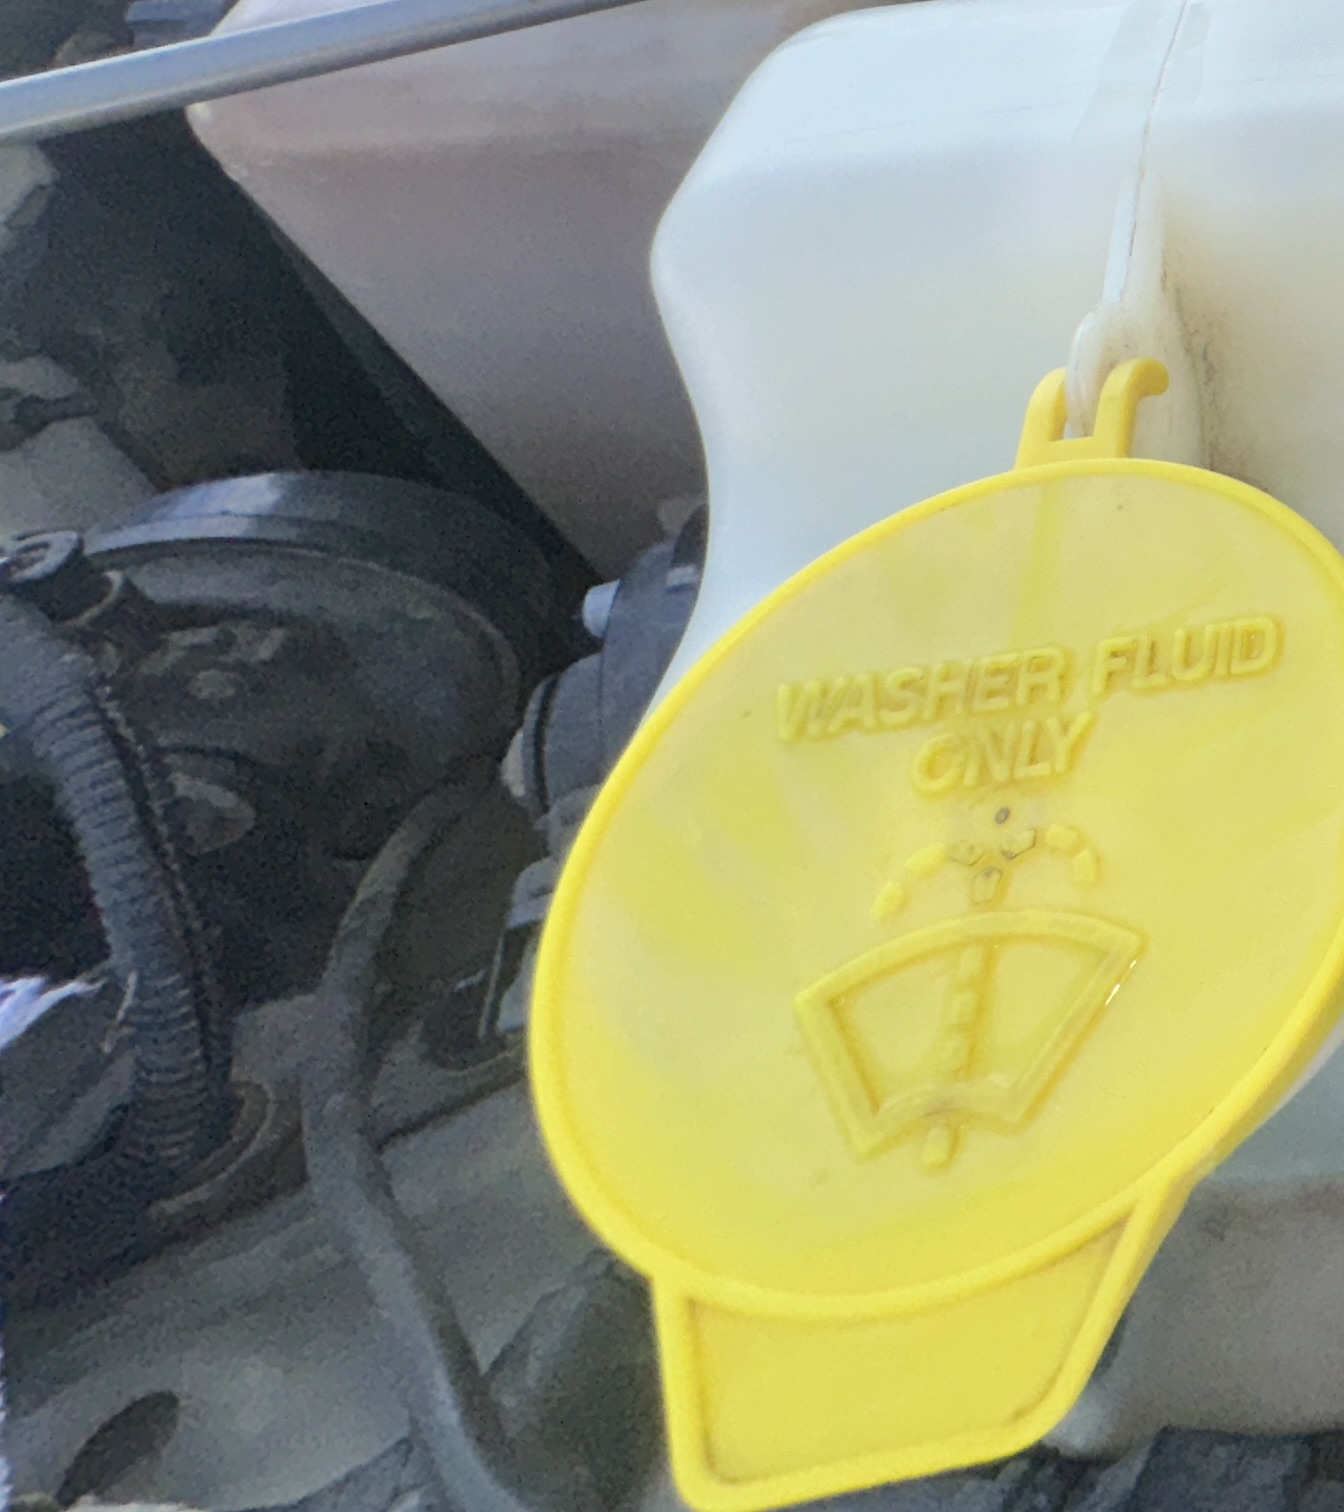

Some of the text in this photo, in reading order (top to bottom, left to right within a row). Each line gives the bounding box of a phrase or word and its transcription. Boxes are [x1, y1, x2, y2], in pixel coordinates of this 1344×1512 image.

[776, 615, 1284, 741] WASHER FLUID
[911, 711, 1094, 795] ONLY
